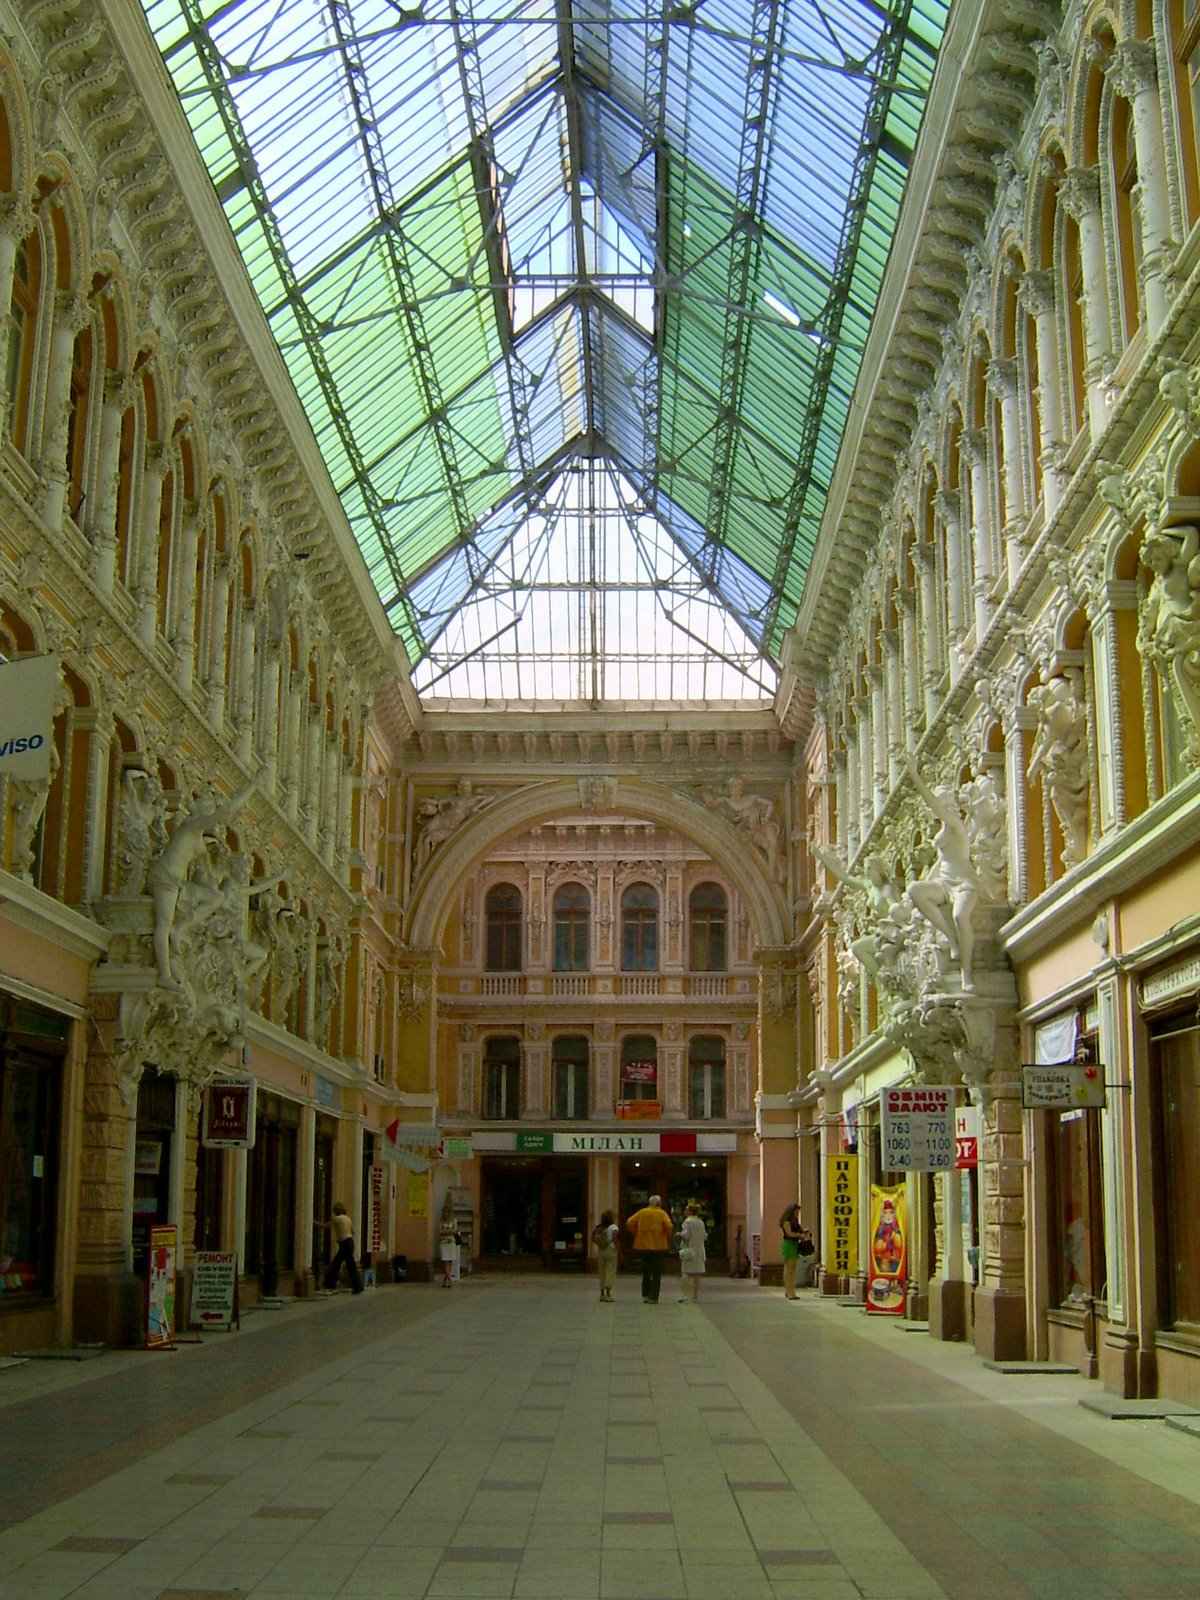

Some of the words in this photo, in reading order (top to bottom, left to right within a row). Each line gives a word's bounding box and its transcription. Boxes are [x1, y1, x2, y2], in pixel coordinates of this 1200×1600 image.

[889, 1092, 947, 1101] ОБМІН
[888, 1103, 949, 1112] ВАЛЮТ
[571, 1137, 643, 1150] МІЛАН
[834, 1161, 852, 1270] ПАРФЮМЕРИЯ
[198, 1253, 233, 1264] РЕМОНТ
